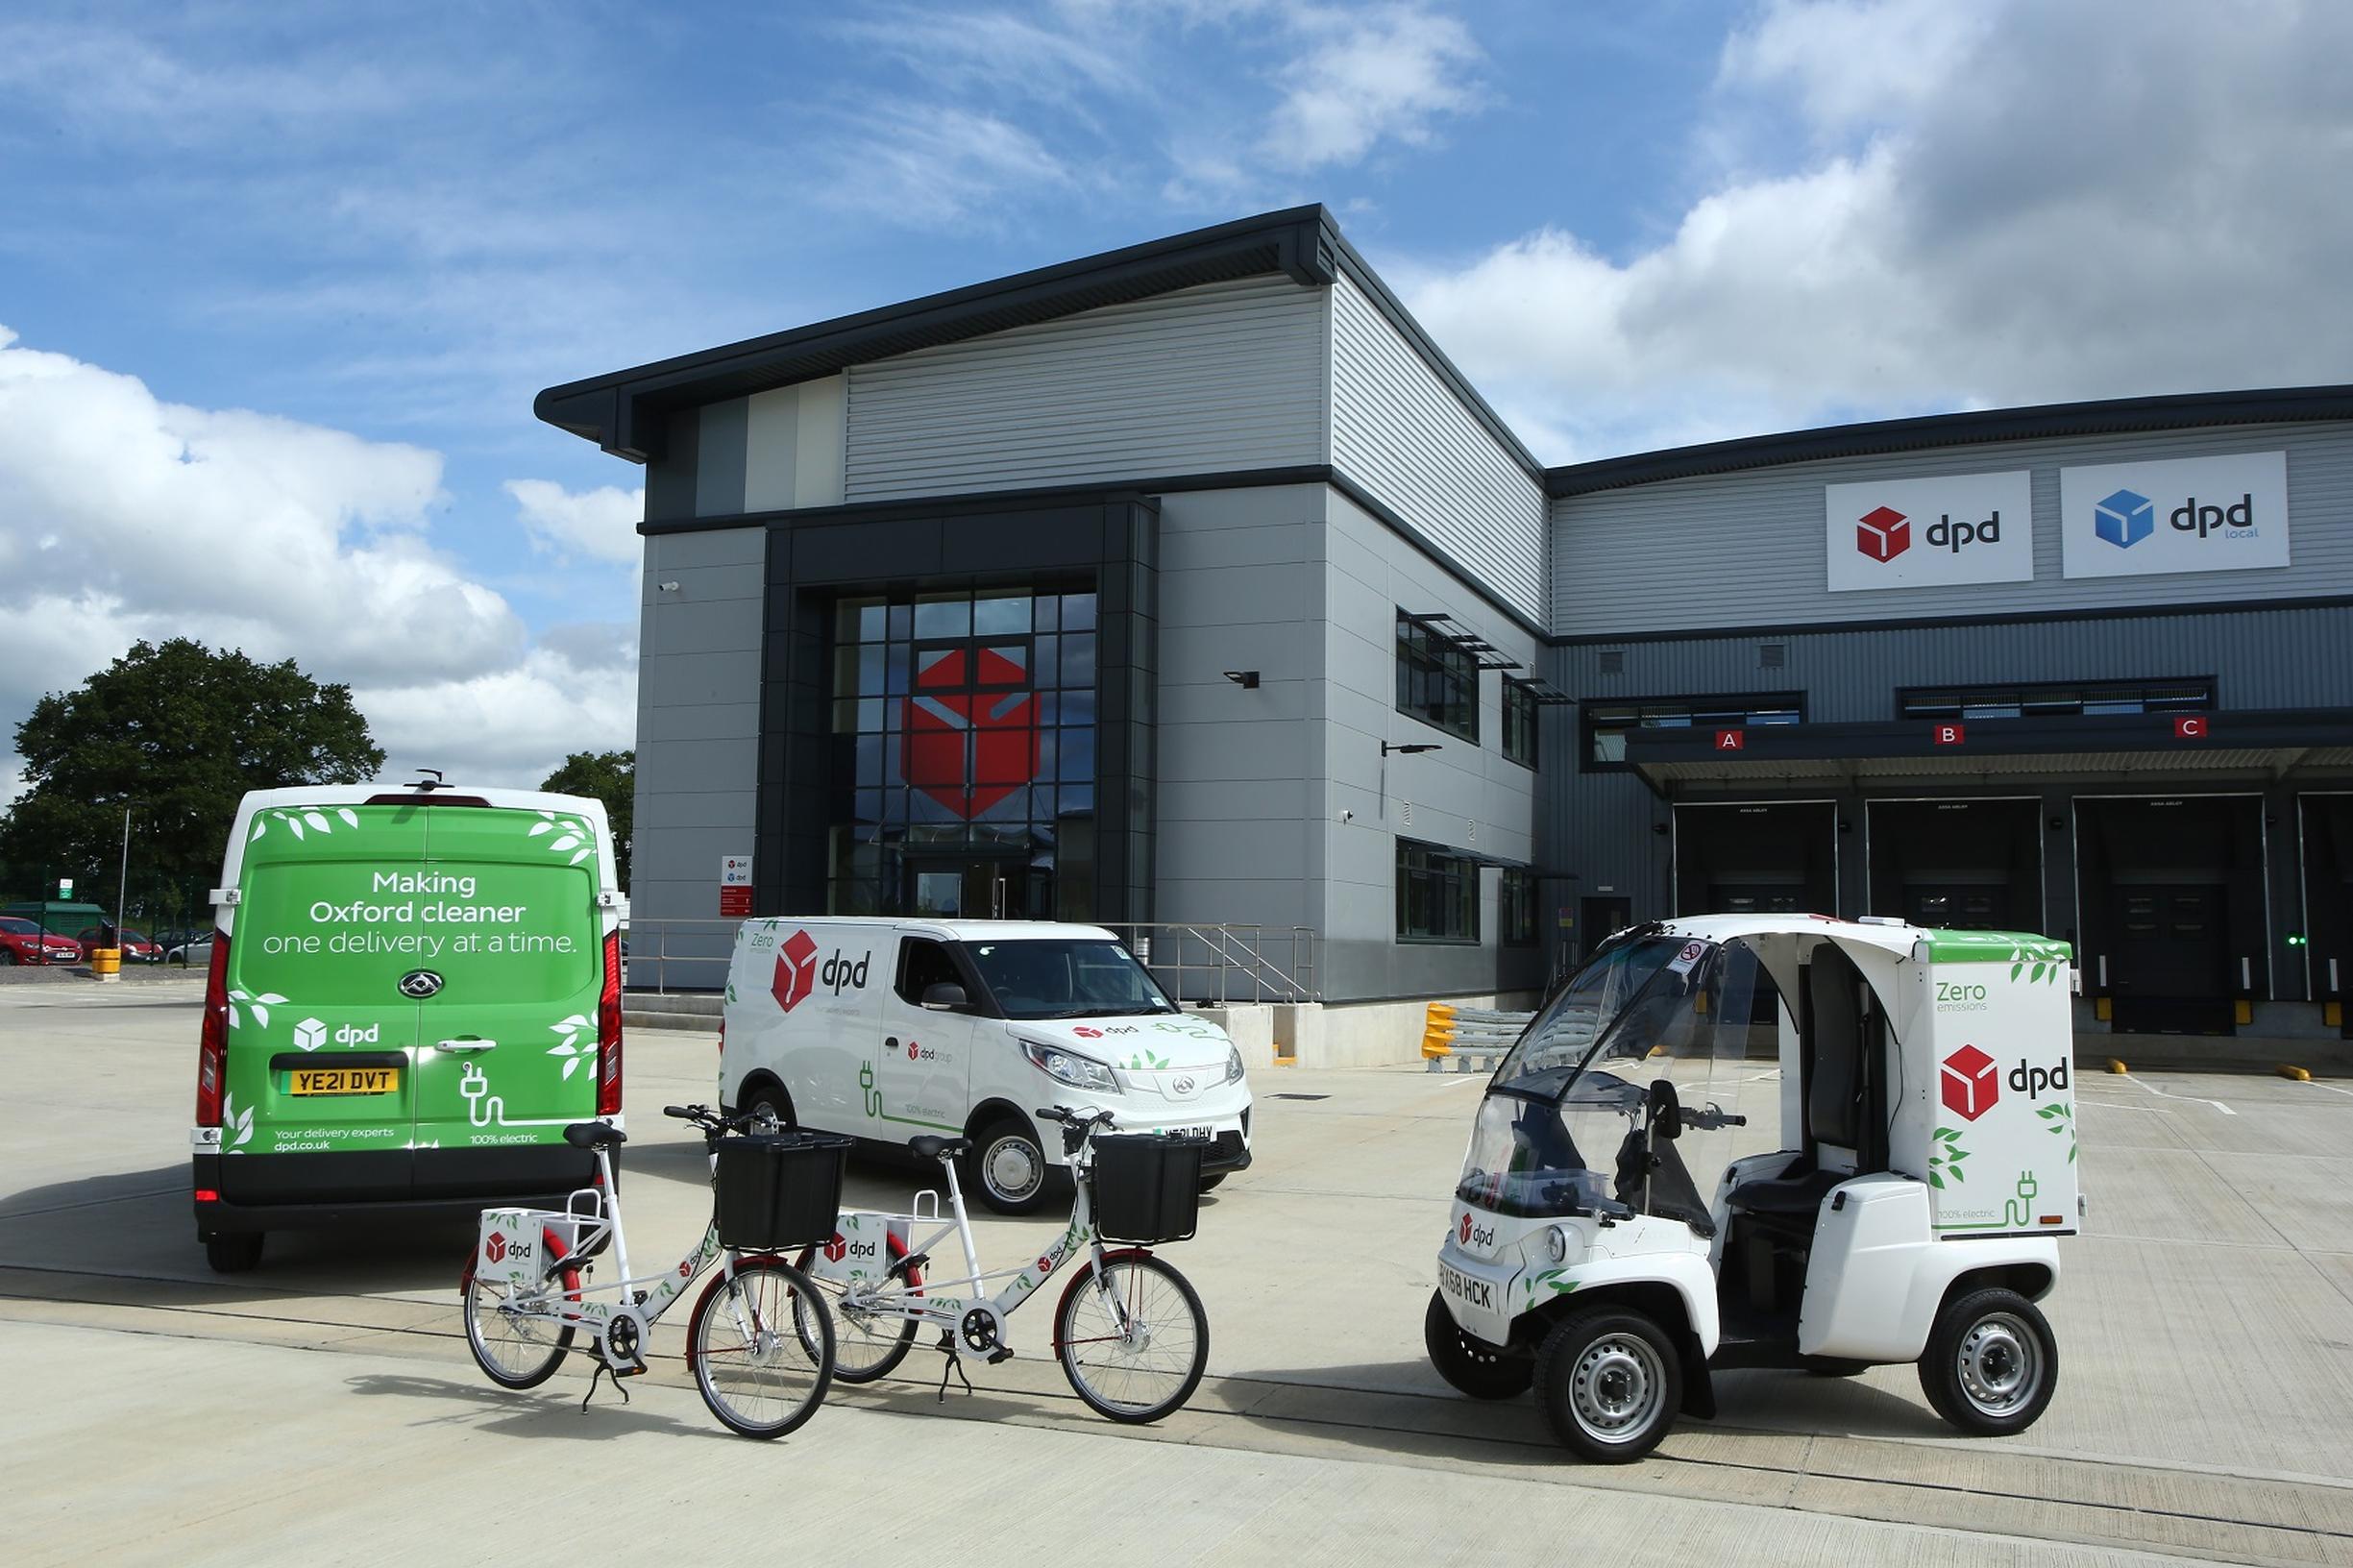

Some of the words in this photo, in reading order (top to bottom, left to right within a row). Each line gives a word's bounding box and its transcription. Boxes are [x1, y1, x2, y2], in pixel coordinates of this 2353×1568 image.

[2169, 493, 2252, 538] dpd
[1925, 511, 2000, 553] dpd
[2224, 526, 2260, 540] local
[1942, 727, 1956, 743] B
[2182, 720, 2198, 735] C
[1722, 733, 1736, 748] A
[373, 871, 477, 897] Making
[310, 900, 413, 923] Oxford
[421, 900, 527, 923] cleaner
[263, 934, 320, 954] one
[330, 930, 445, 957] delivery
[453, 931, 481, 952] at
[488, 936, 503, 952] a
[508, 930, 577, 953] time.
[751, 932, 774, 948] Zero
[822, 948, 871, 996] dpd
[1936, 982, 1987, 1001] Zero
[1937, 1001, 1988, 1012] emissions
[335, 1022, 379, 1047] dpd
[1105, 1025, 1139, 1036] dpd
[300, 1072, 344, 1090] YE21
[351, 1071, 390, 1089] DVT
[2008, 1057, 2069, 1099] dpd
[276, 1129, 303, 1139] Your
[305, 1128, 350, 1139] delivery
[352, 1127, 394, 1139] experts
[470, 1134, 498, 1144] 100%
[500, 1133, 538, 1143] electric
[274, 1140, 330, 1152] dpd.co.uk
[1962, 1209, 1996, 1218] electric
[1473, 1224, 1495, 1247] dpd
[508, 1240, 531, 1260] dpd
[850, 1240, 875, 1259] dpd
[1463, 1277, 1491, 1309] HCK
